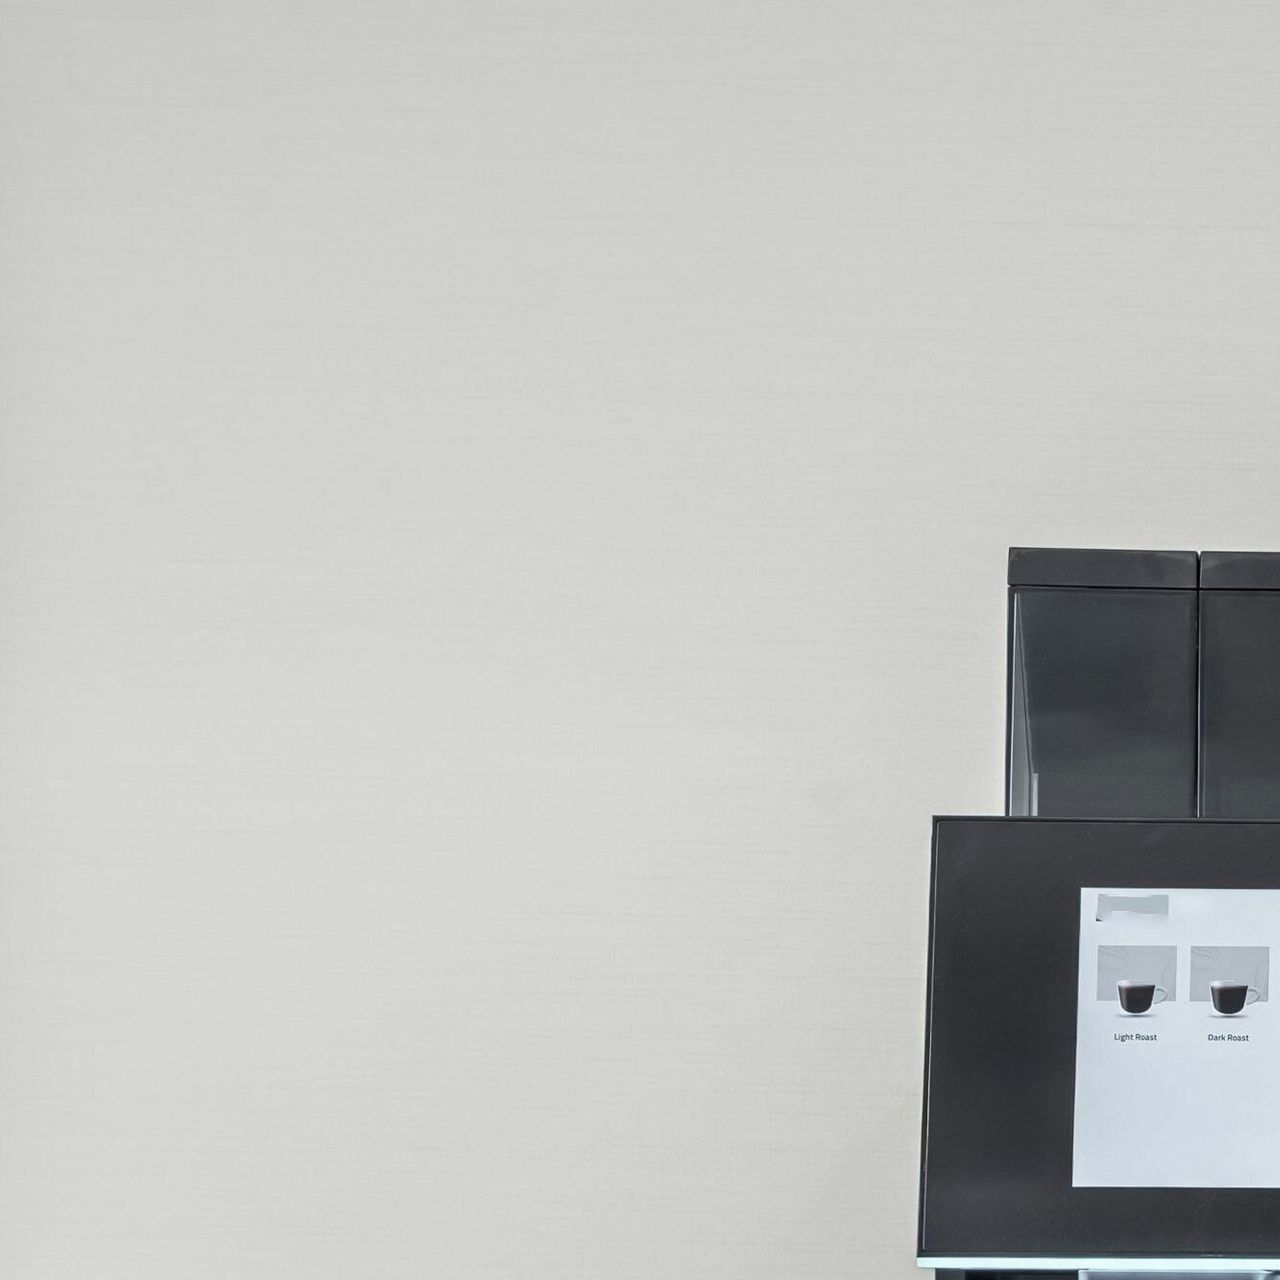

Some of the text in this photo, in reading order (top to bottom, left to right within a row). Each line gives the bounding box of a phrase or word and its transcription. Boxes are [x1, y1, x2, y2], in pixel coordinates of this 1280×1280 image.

[1114, 1033, 1158, 1042] Light Roast
[1207, 1033, 1250, 1042] Dark Roast
